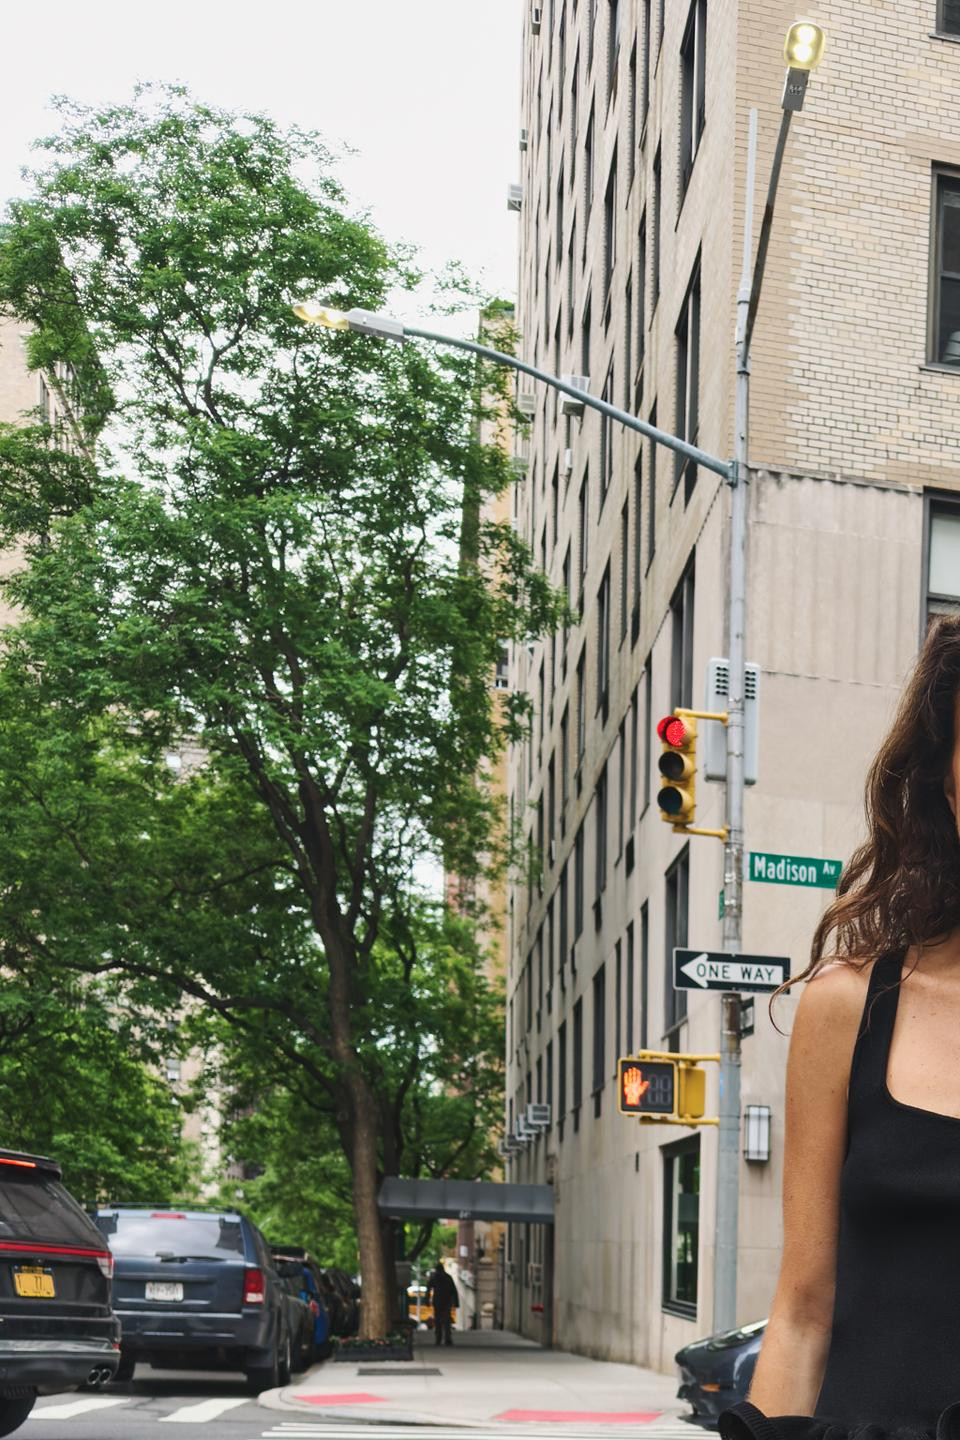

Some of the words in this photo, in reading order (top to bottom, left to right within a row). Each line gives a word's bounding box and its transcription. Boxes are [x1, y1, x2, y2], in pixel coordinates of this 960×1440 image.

[754, 855, 817, 883] Madison
[822, 861, 836, 875] Av
[696, 963, 730, 979] ONE
[741, 965, 775, 981] WAY
